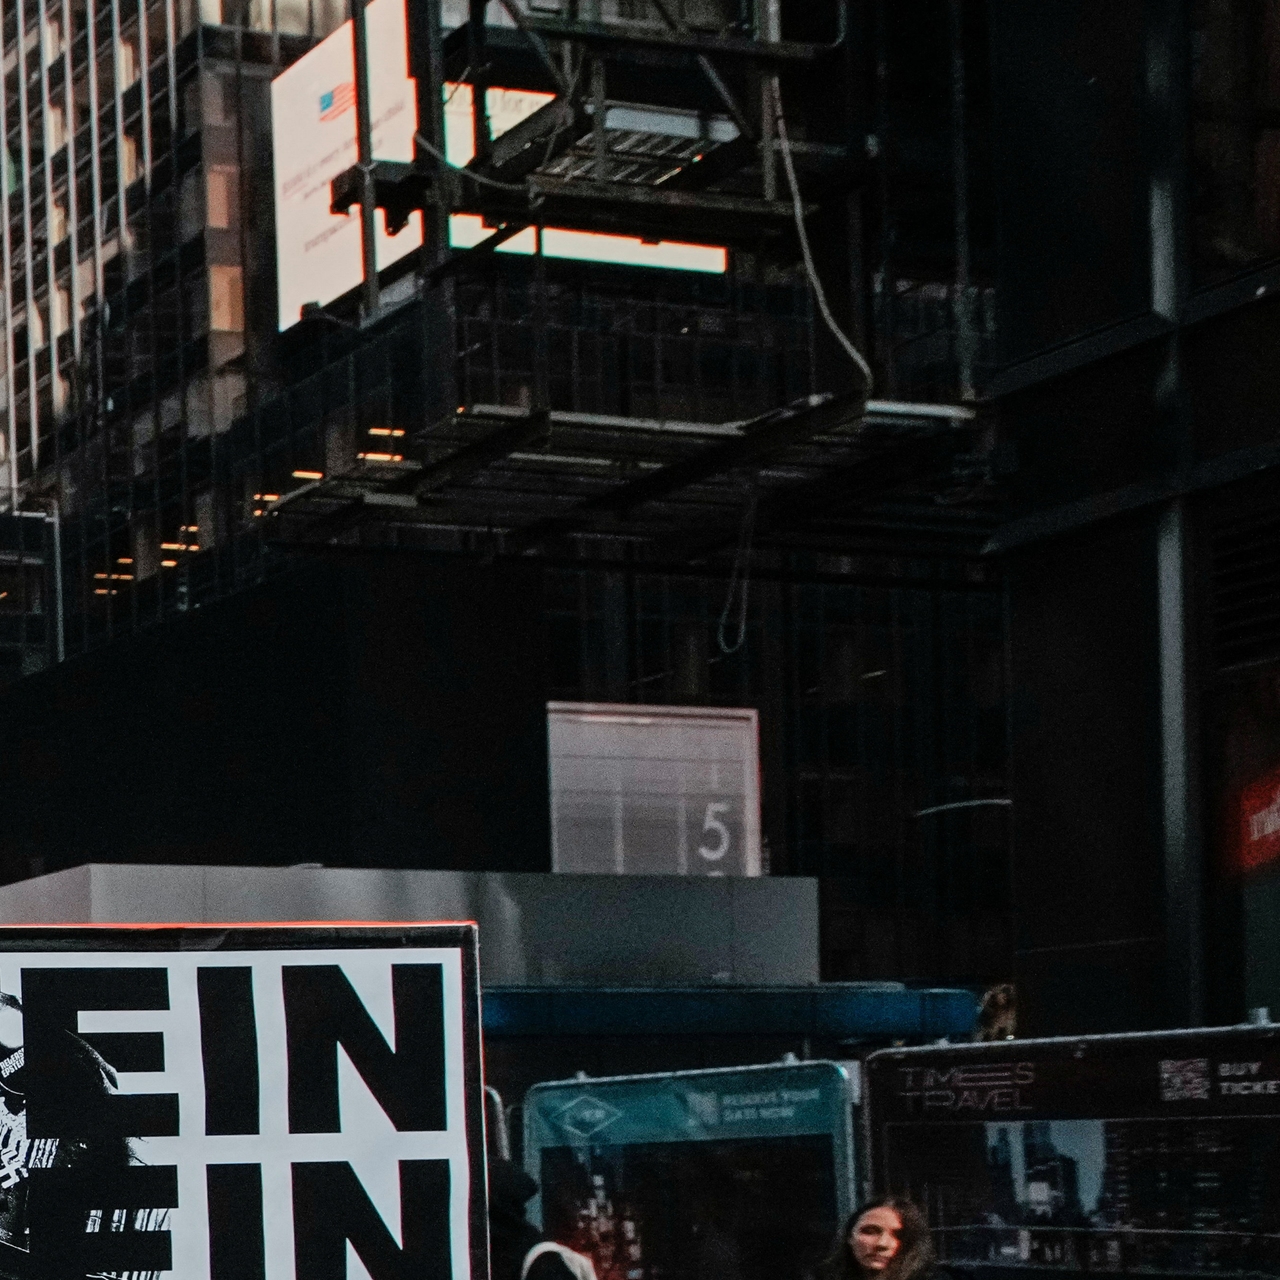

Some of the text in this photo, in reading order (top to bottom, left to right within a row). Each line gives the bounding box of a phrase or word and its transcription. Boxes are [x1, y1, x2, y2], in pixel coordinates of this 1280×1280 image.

[899, 1062, 1035, 1088] TIMES
[1218, 1061, 1262, 1076] BUY
[900, 1087, 1033, 1111] TRAVEL
